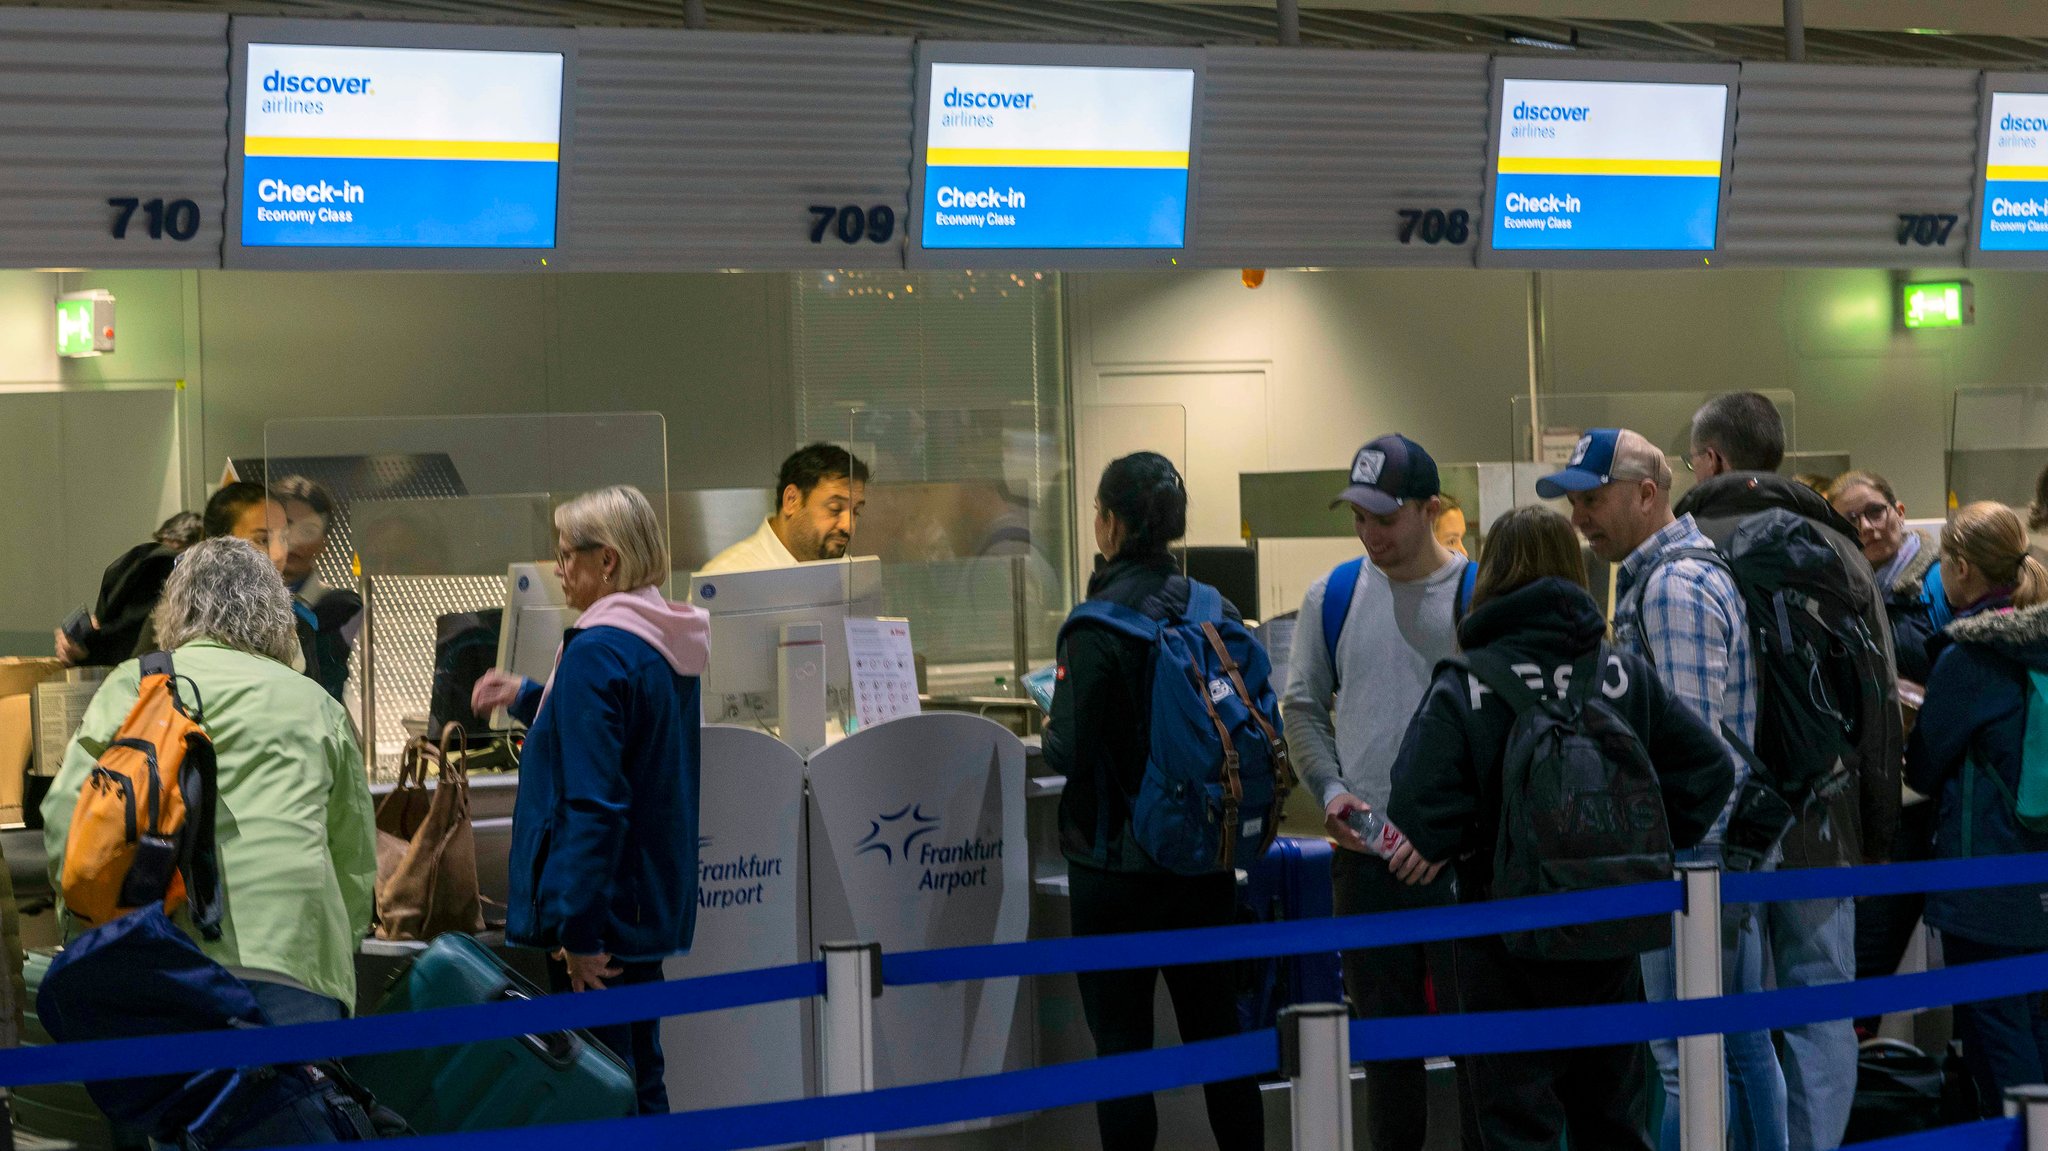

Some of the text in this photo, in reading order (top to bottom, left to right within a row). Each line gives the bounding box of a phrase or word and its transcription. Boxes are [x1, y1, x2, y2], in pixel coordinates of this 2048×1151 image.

[261, 95, 324, 114] airlines
[941, 111, 994, 128] airlines
[1510, 121, 1556, 138] airlines
[1998, 133, 2037, 148] airlines
[258, 178, 365, 203] Check-in
[937, 186, 1026, 209] Check-in
[1505, 192, 1581, 213] Check-in
[107, 197, 201, 241] 710
[257, 206, 353, 225] Economy Class
[808, 204, 895, 244] 709
[935, 212, 1016, 228] Economy Class
[1397, 207, 1469, 245] 708
[1504, 216, 1572, 232] Economy Class
[1897, 213, 1958, 246] 707
[1990, 219, 2027, 234] Economy
[920, 836, 1004, 865] Frankfurt
[918, 865, 986, 896] Airport
